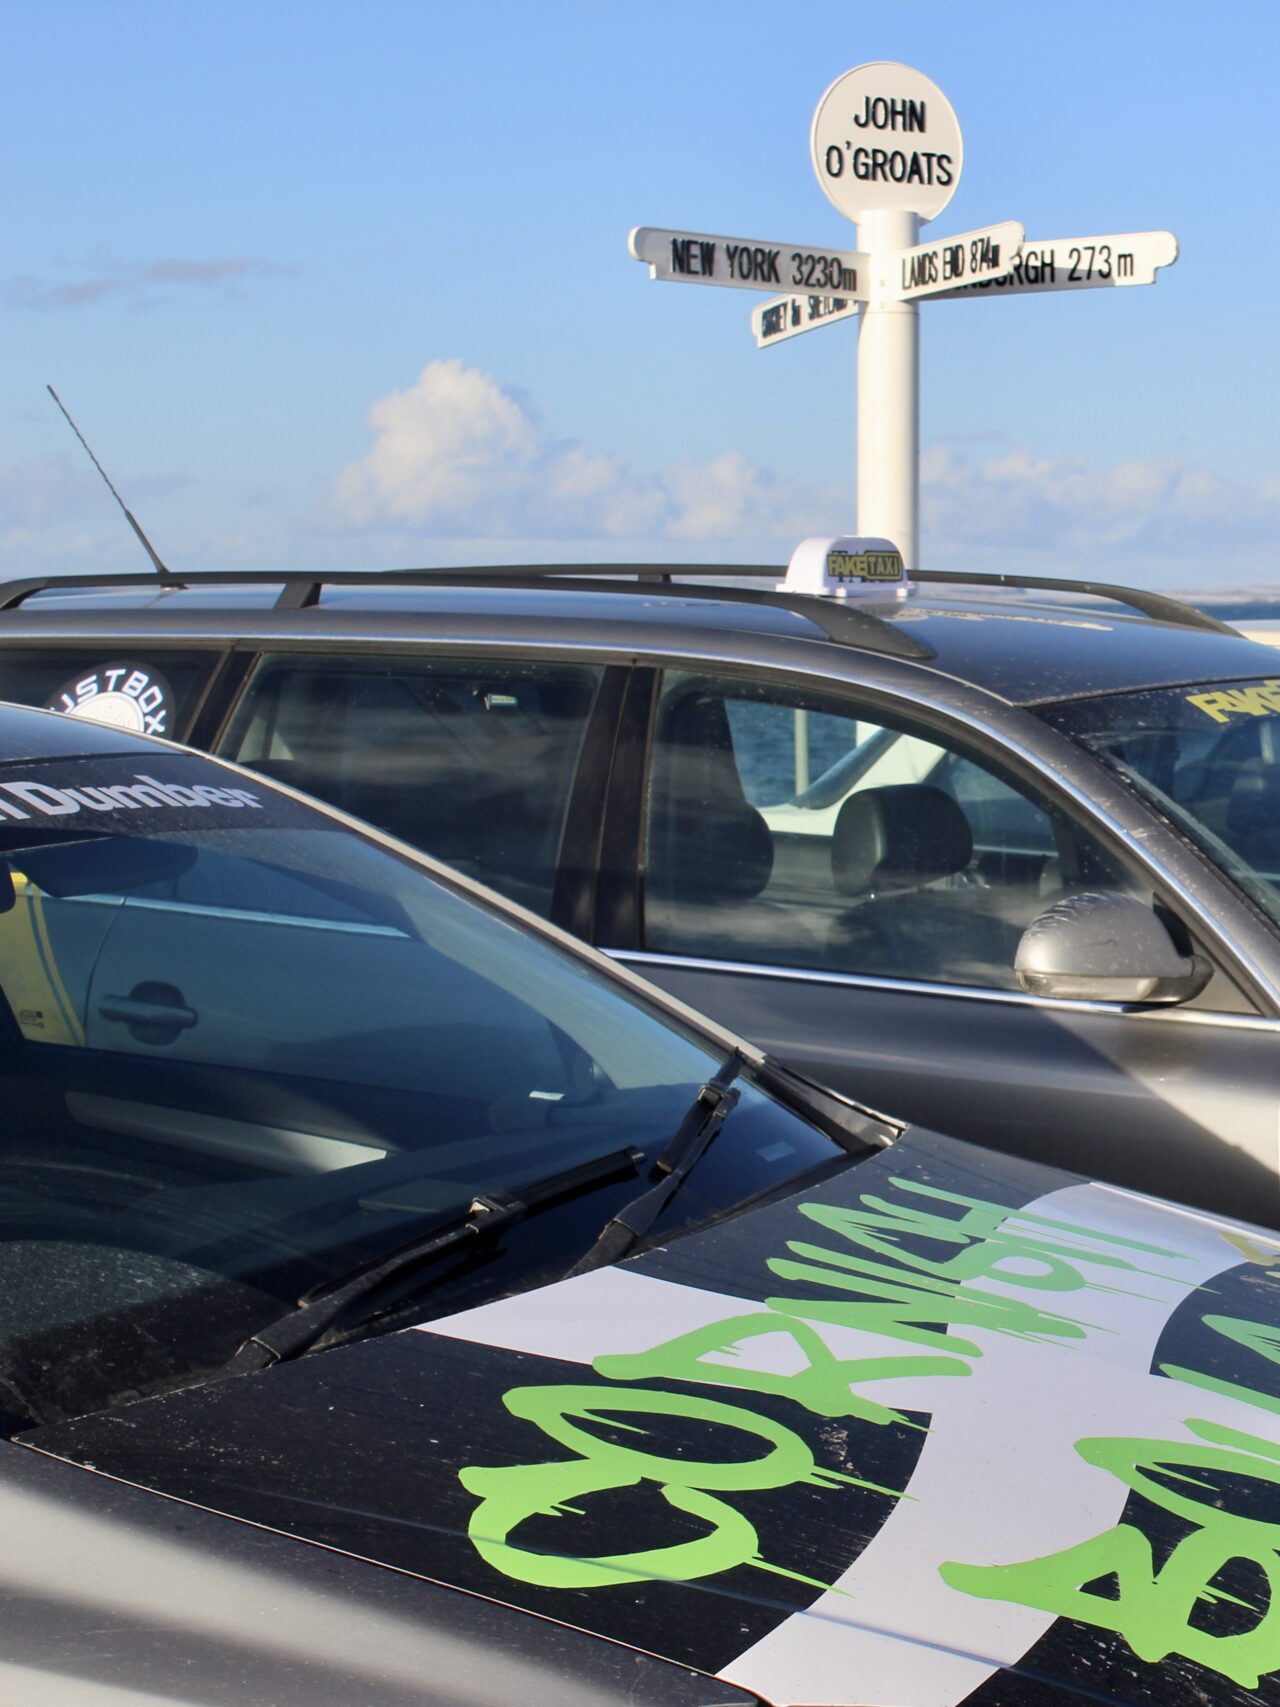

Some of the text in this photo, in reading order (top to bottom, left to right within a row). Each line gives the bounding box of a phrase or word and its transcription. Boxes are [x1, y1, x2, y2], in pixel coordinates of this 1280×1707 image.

[854, 96, 926, 133] JOHN
[826, 141, 953, 186] O'GROATS
[671, 238, 857, 292] NEW YORK 3230m
[902, 251, 938, 290] LANDS
[943, 244, 965, 281] END
[827, 553, 899, 577] FAKE TAXI
[50, 668, 166, 735] USTBOX
[0, 775, 264, 816] Dumber
[459, 1177, 1190, 1590] CORNISH
